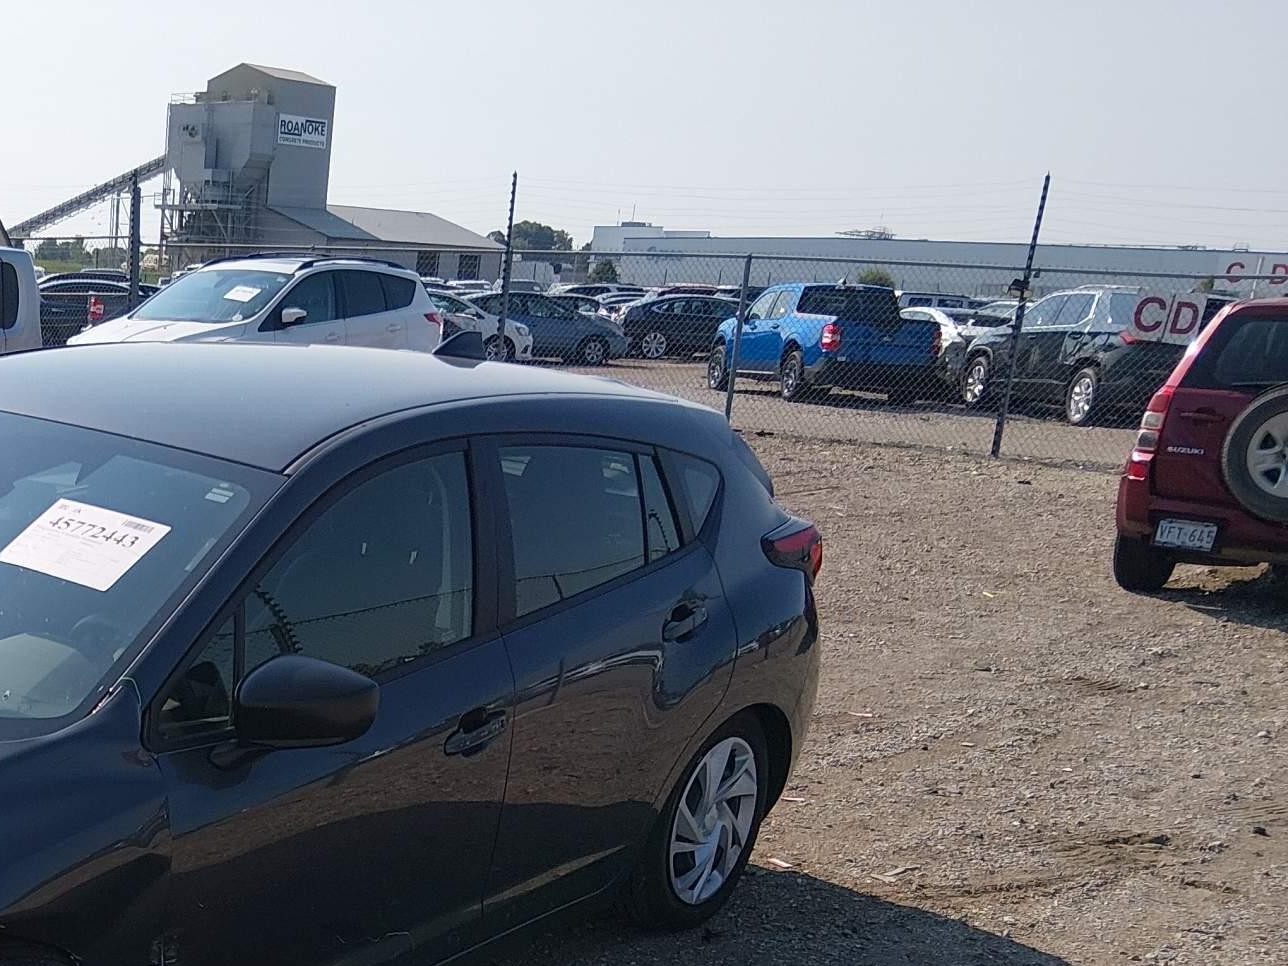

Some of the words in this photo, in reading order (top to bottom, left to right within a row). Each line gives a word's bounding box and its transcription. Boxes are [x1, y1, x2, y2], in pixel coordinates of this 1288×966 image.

[280, 120, 326, 136] ROANOKE
[1166, 446, 1205, 456] SUZUKI
[48, 516, 140, 548] 45772443
